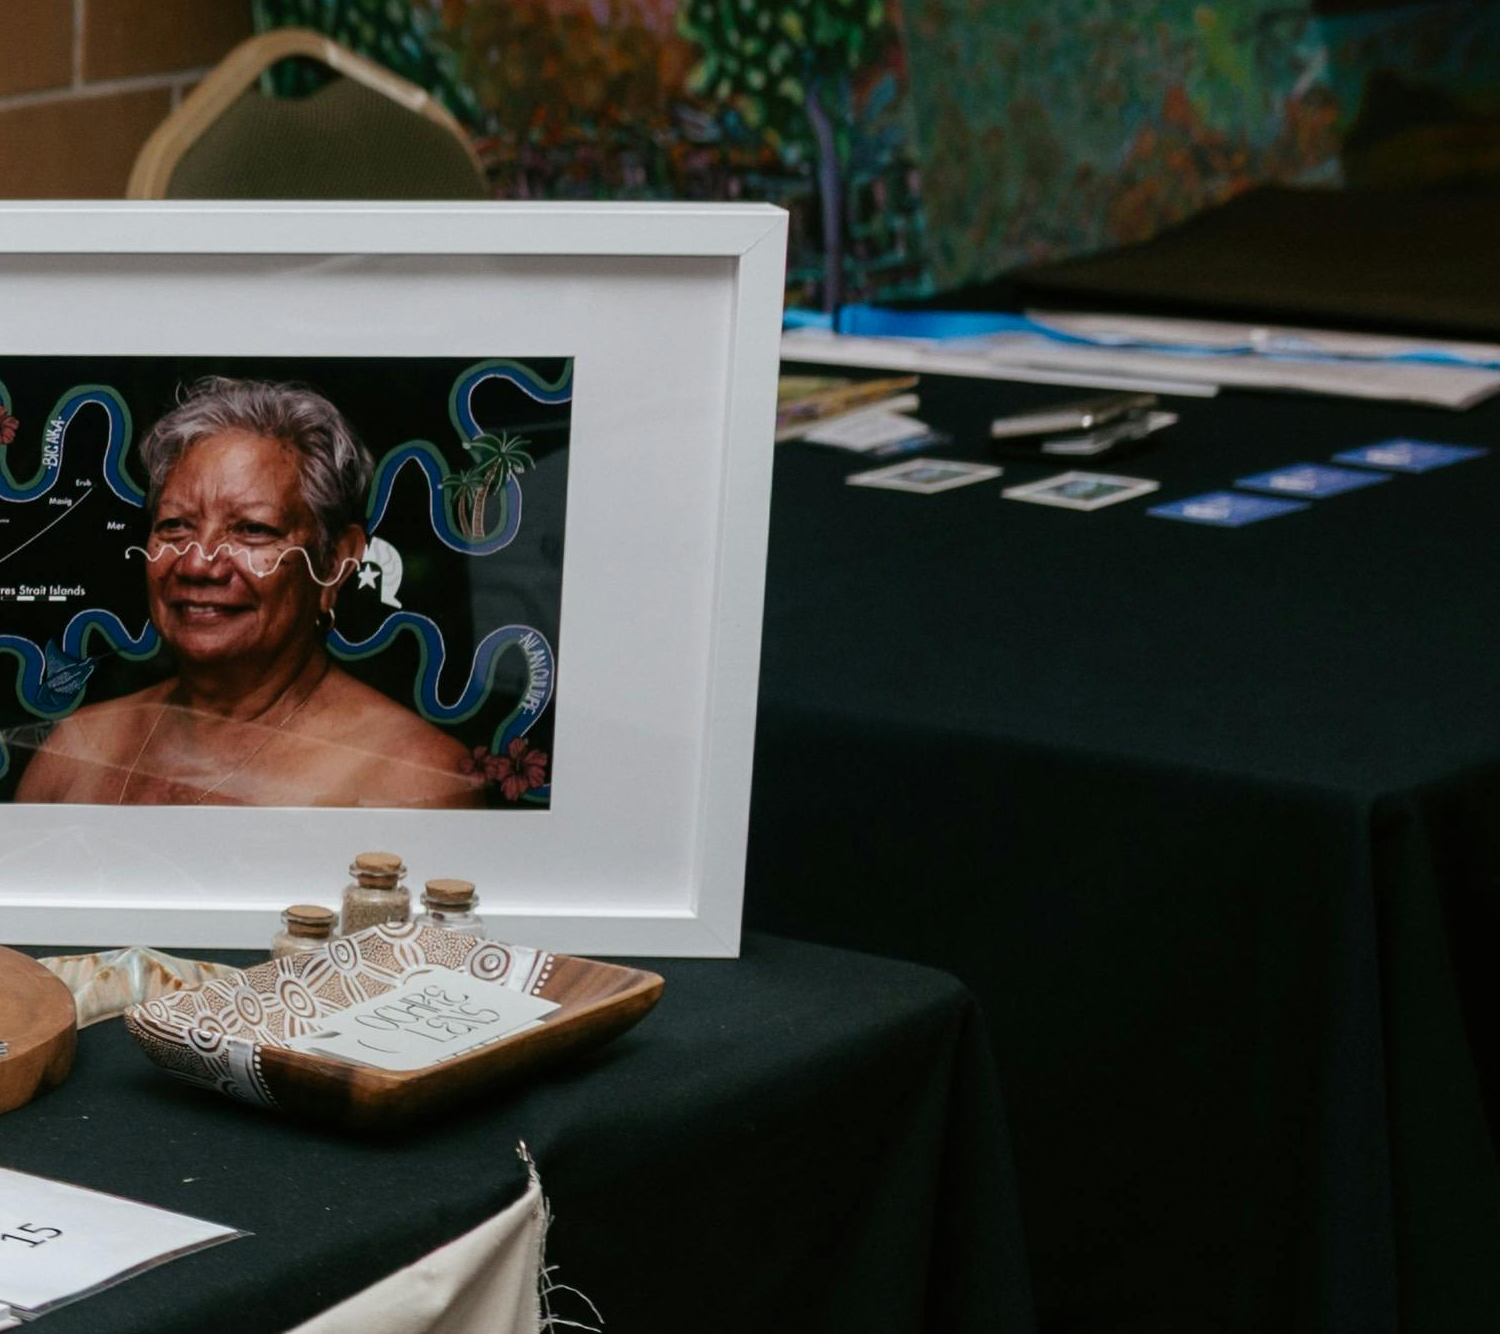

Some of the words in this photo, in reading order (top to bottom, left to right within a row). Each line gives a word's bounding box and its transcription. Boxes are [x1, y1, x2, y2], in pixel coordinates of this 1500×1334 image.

[107, 521, 126, 531] Mer
[18, 584, 47, 596] Strait
[49, 584, 86, 596] Islands
[0, 1222, 63, 1249] 15
